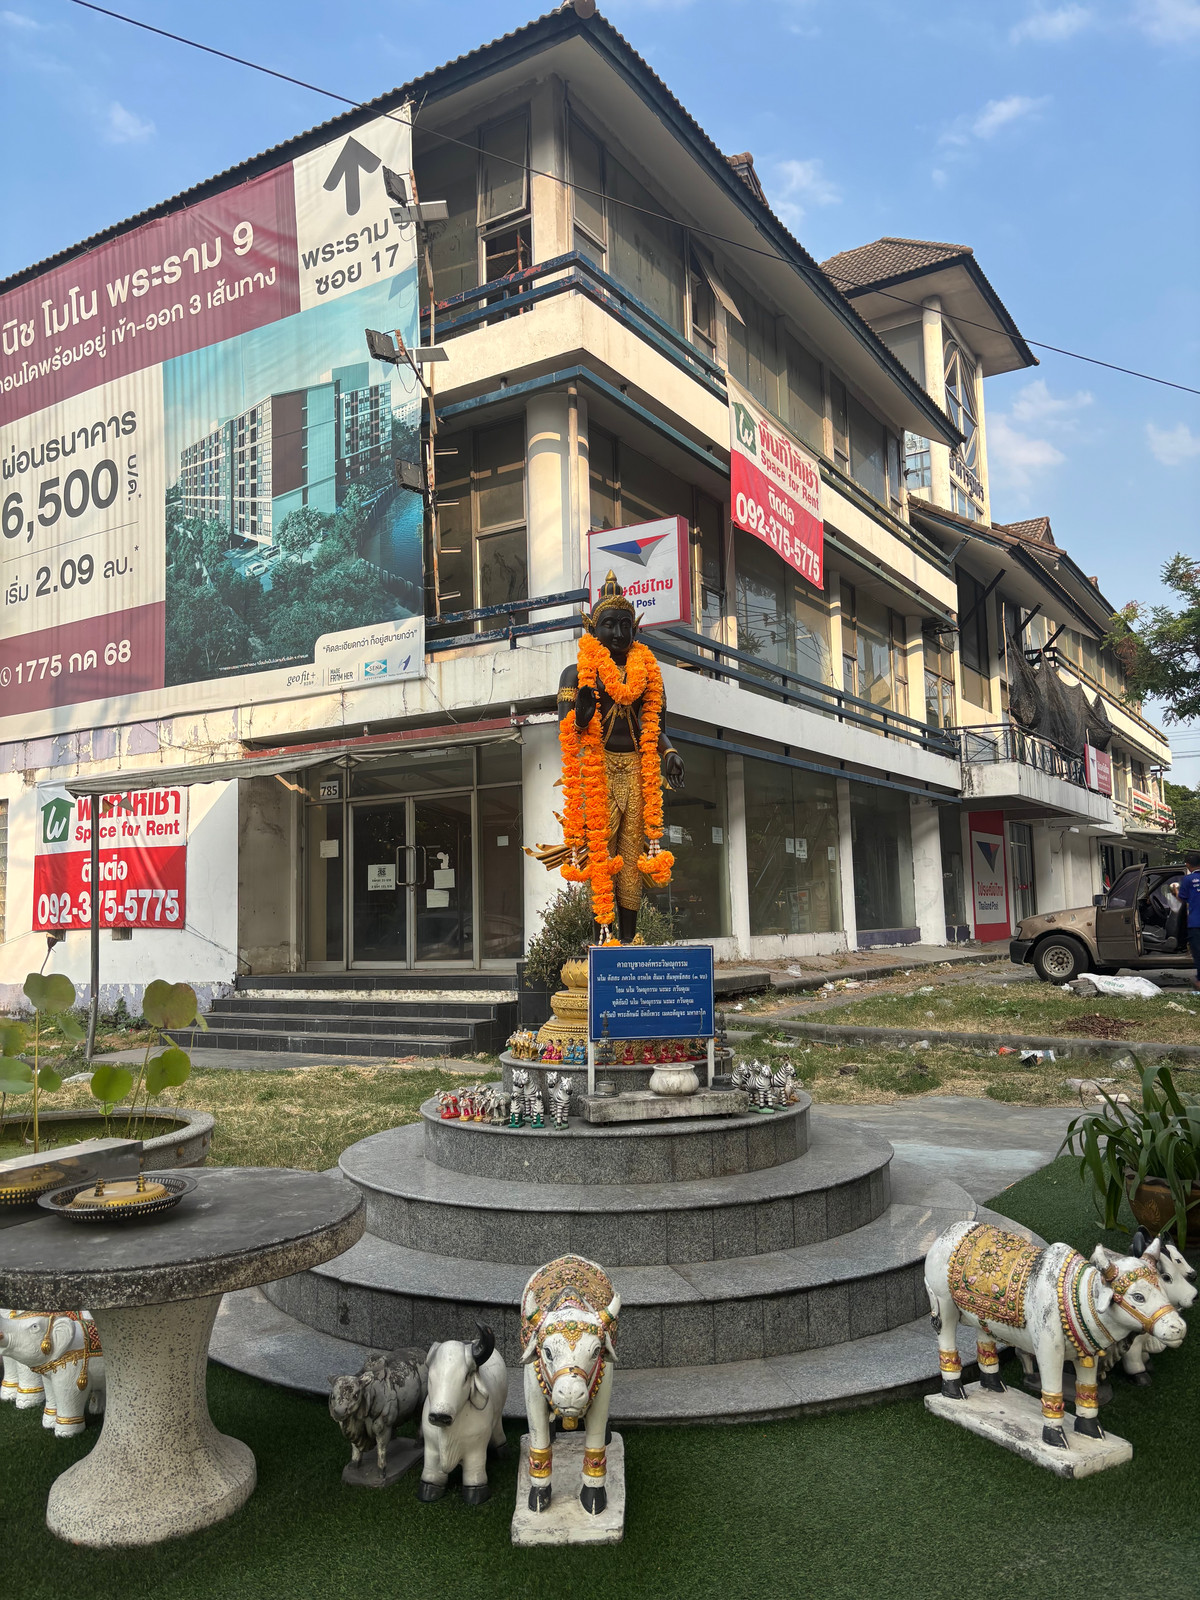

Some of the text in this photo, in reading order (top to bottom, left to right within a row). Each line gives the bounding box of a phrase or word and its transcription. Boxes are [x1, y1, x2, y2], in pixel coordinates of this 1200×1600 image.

[301, 218, 389, 270] พระราม
[315, 243, 399, 296] ซอย 17
[2, 220, 254, 356] นิช โมโน พระราม 9
[111, 303, 184, 346] เข้า-ออก
[189, 294, 202, 315] 3
[207, 266, 276, 309] เส้นทาง
[2, 410, 137, 480] ผ่อนธนาคาร
[758, 418, 820, 495] พื้นที่ให้เช่า
[1, 458, 119, 543] 6,500
[760, 449, 820, 512] Space for Rent
[768, 485, 795, 526] ติดต่อ
[735, 492, 820, 582] 092-375-5775
[5, 575, 29, 606] เริ่ม
[35, 553, 95, 598] 2.09
[636, 597, 656, 608] Post
[15, 639, 132, 684] 1775 กด 68
[343, 671, 354, 681] HER
[321, 785, 338, 797] 785
[75, 819, 180, 843] Spce for Rent
[81, 854, 128, 883] ติต่อ
